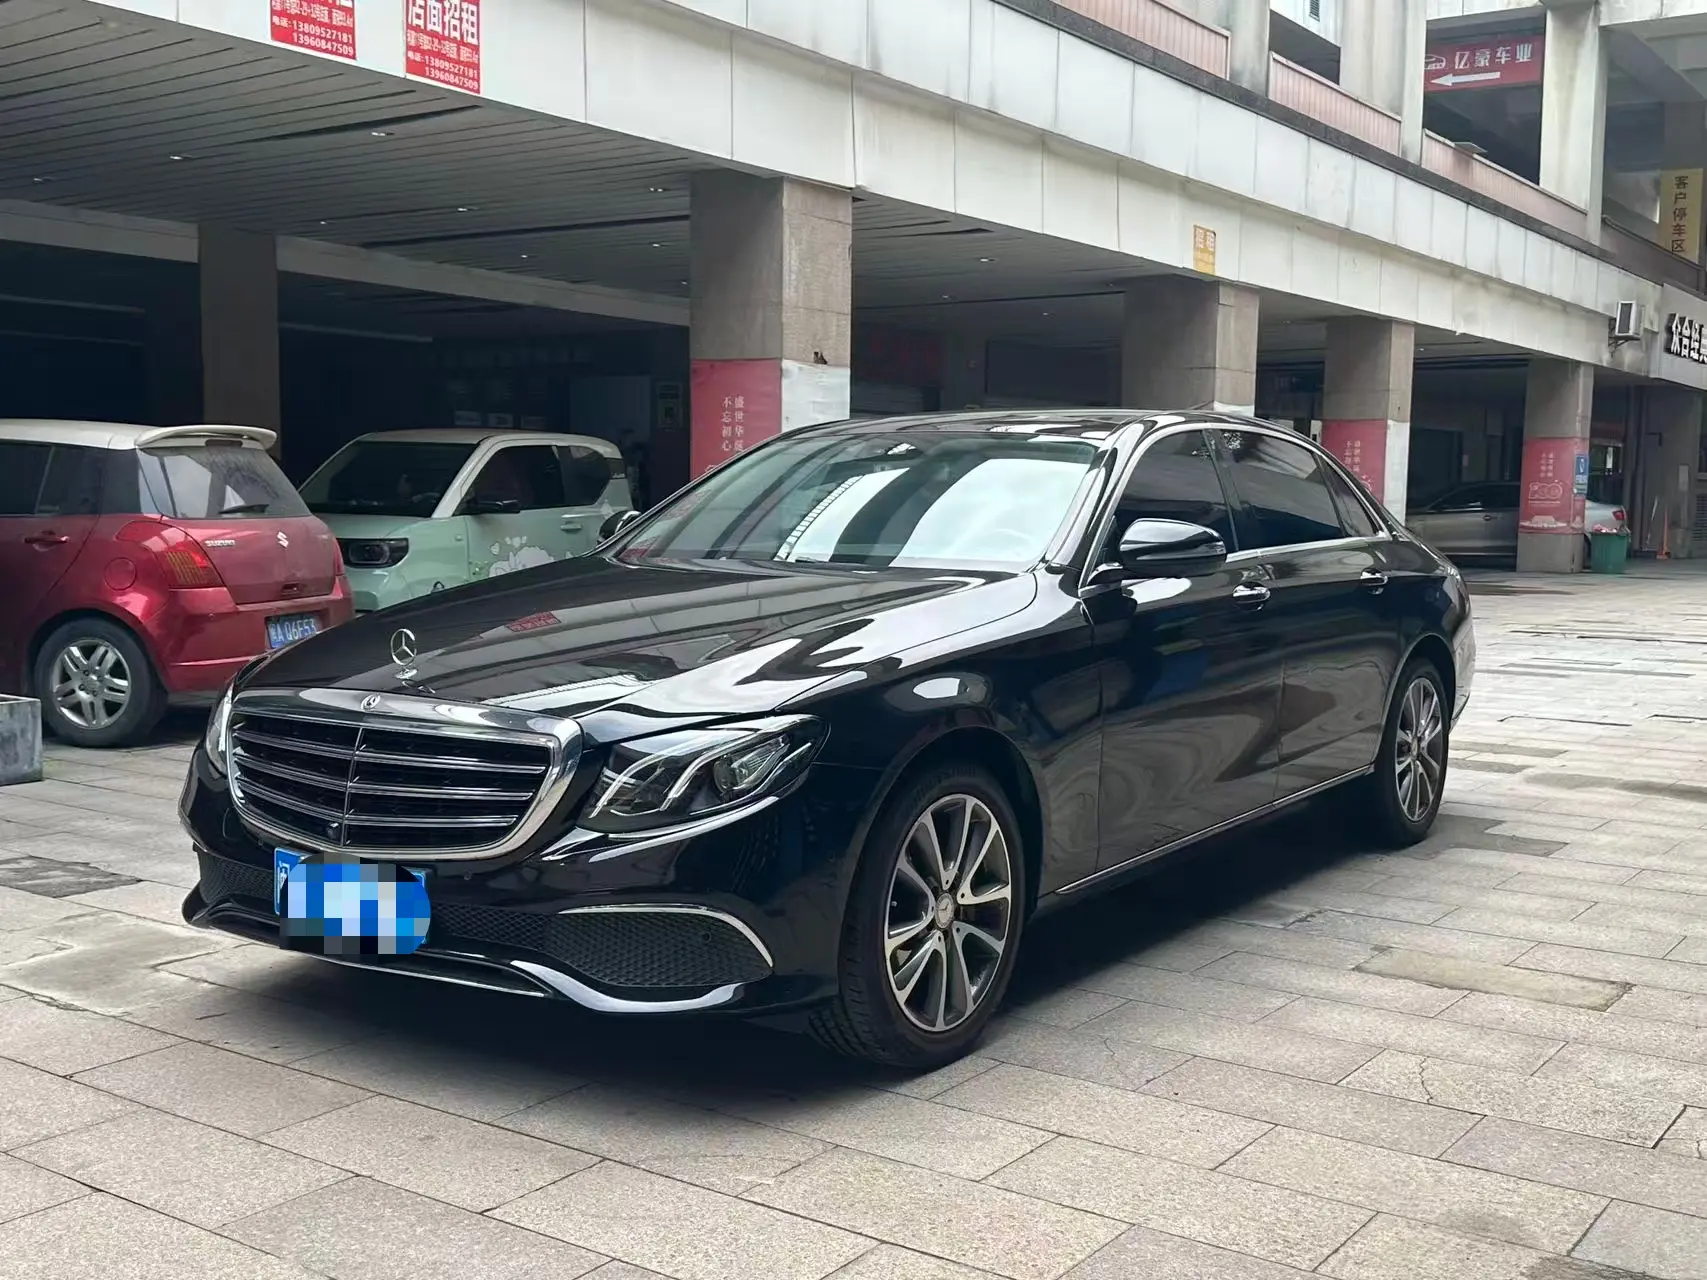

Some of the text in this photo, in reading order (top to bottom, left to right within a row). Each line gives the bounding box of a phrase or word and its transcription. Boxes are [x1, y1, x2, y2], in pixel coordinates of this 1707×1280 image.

[408, 0, 478, 45] 店面招租
[292, 31, 354, 56] 13960847509
[1454, 43, 1532, 69] 亿豪车业
[425, 67, 478, 90] 13960847509
[1671, 175, 1689, 254] 客户停车区
[721, 396, 732, 452] 不忘初心
